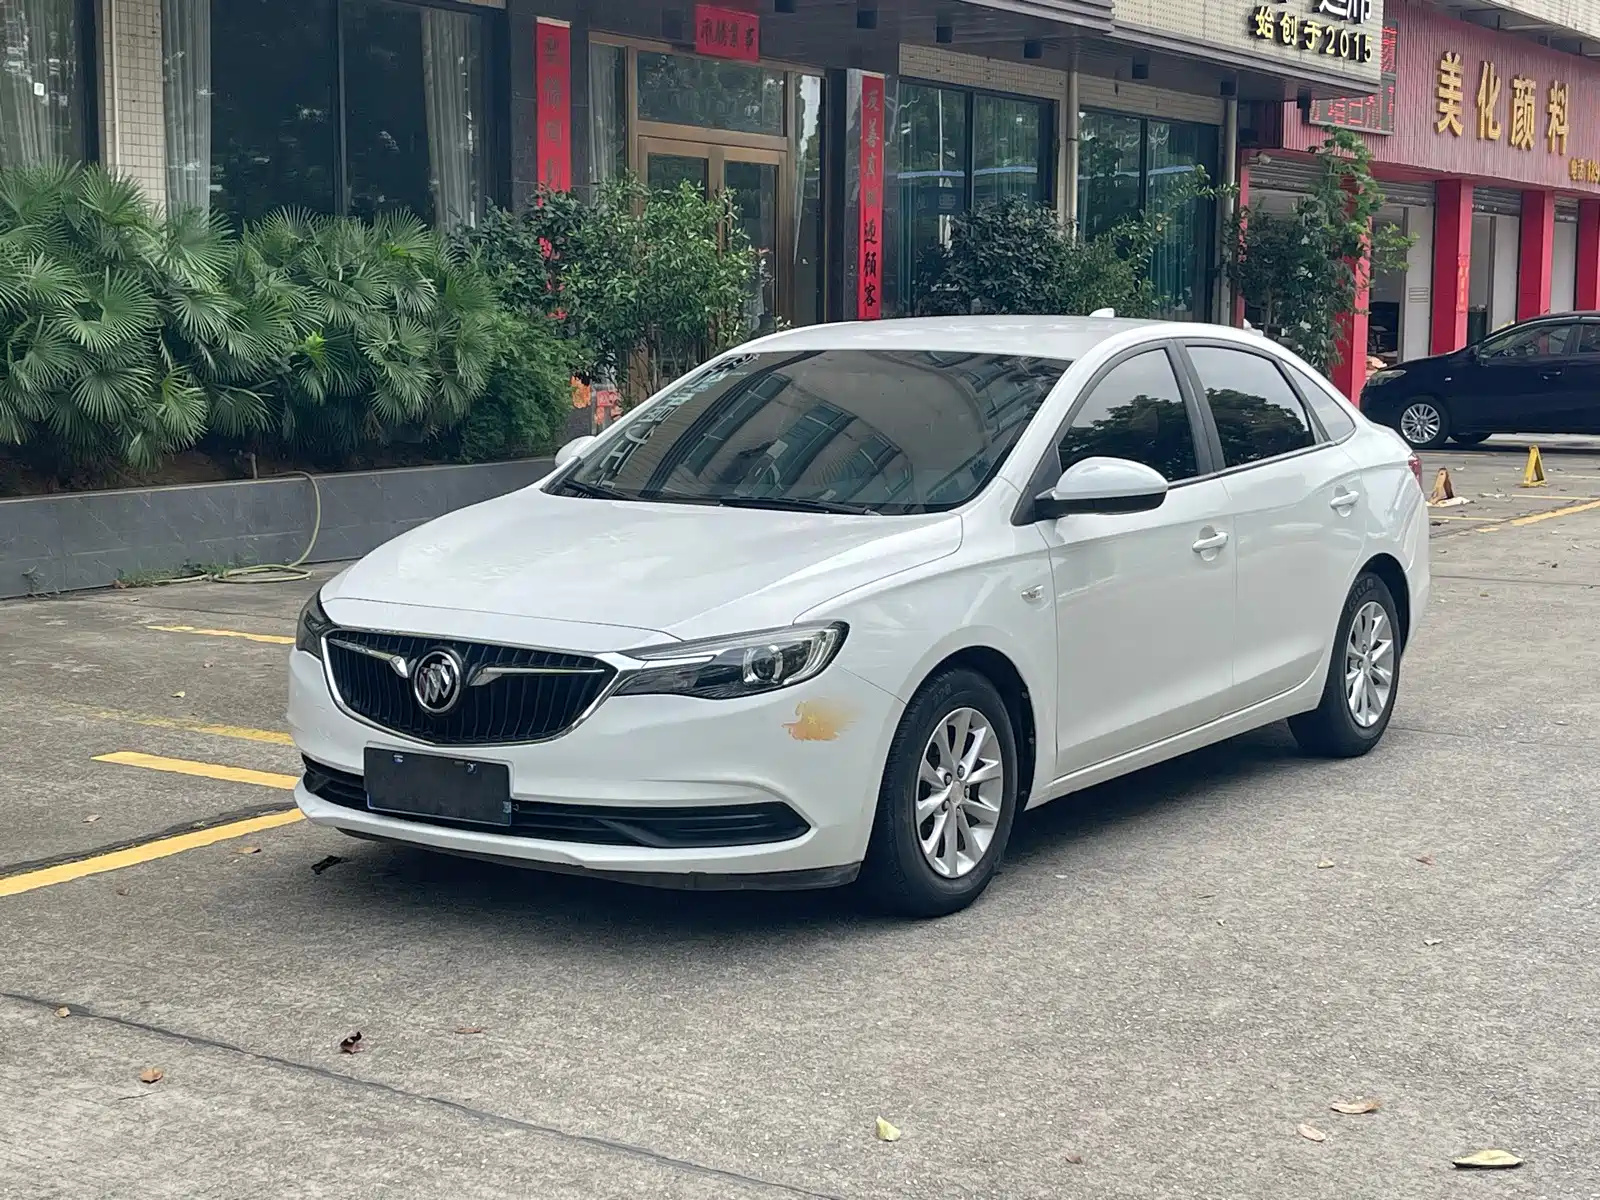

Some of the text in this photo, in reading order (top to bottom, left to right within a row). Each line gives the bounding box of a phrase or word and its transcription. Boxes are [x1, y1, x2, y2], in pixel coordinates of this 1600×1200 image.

[1255, 6, 1373, 62] 始创于2015
[1437, 51, 1570, 156] 美化颜料
